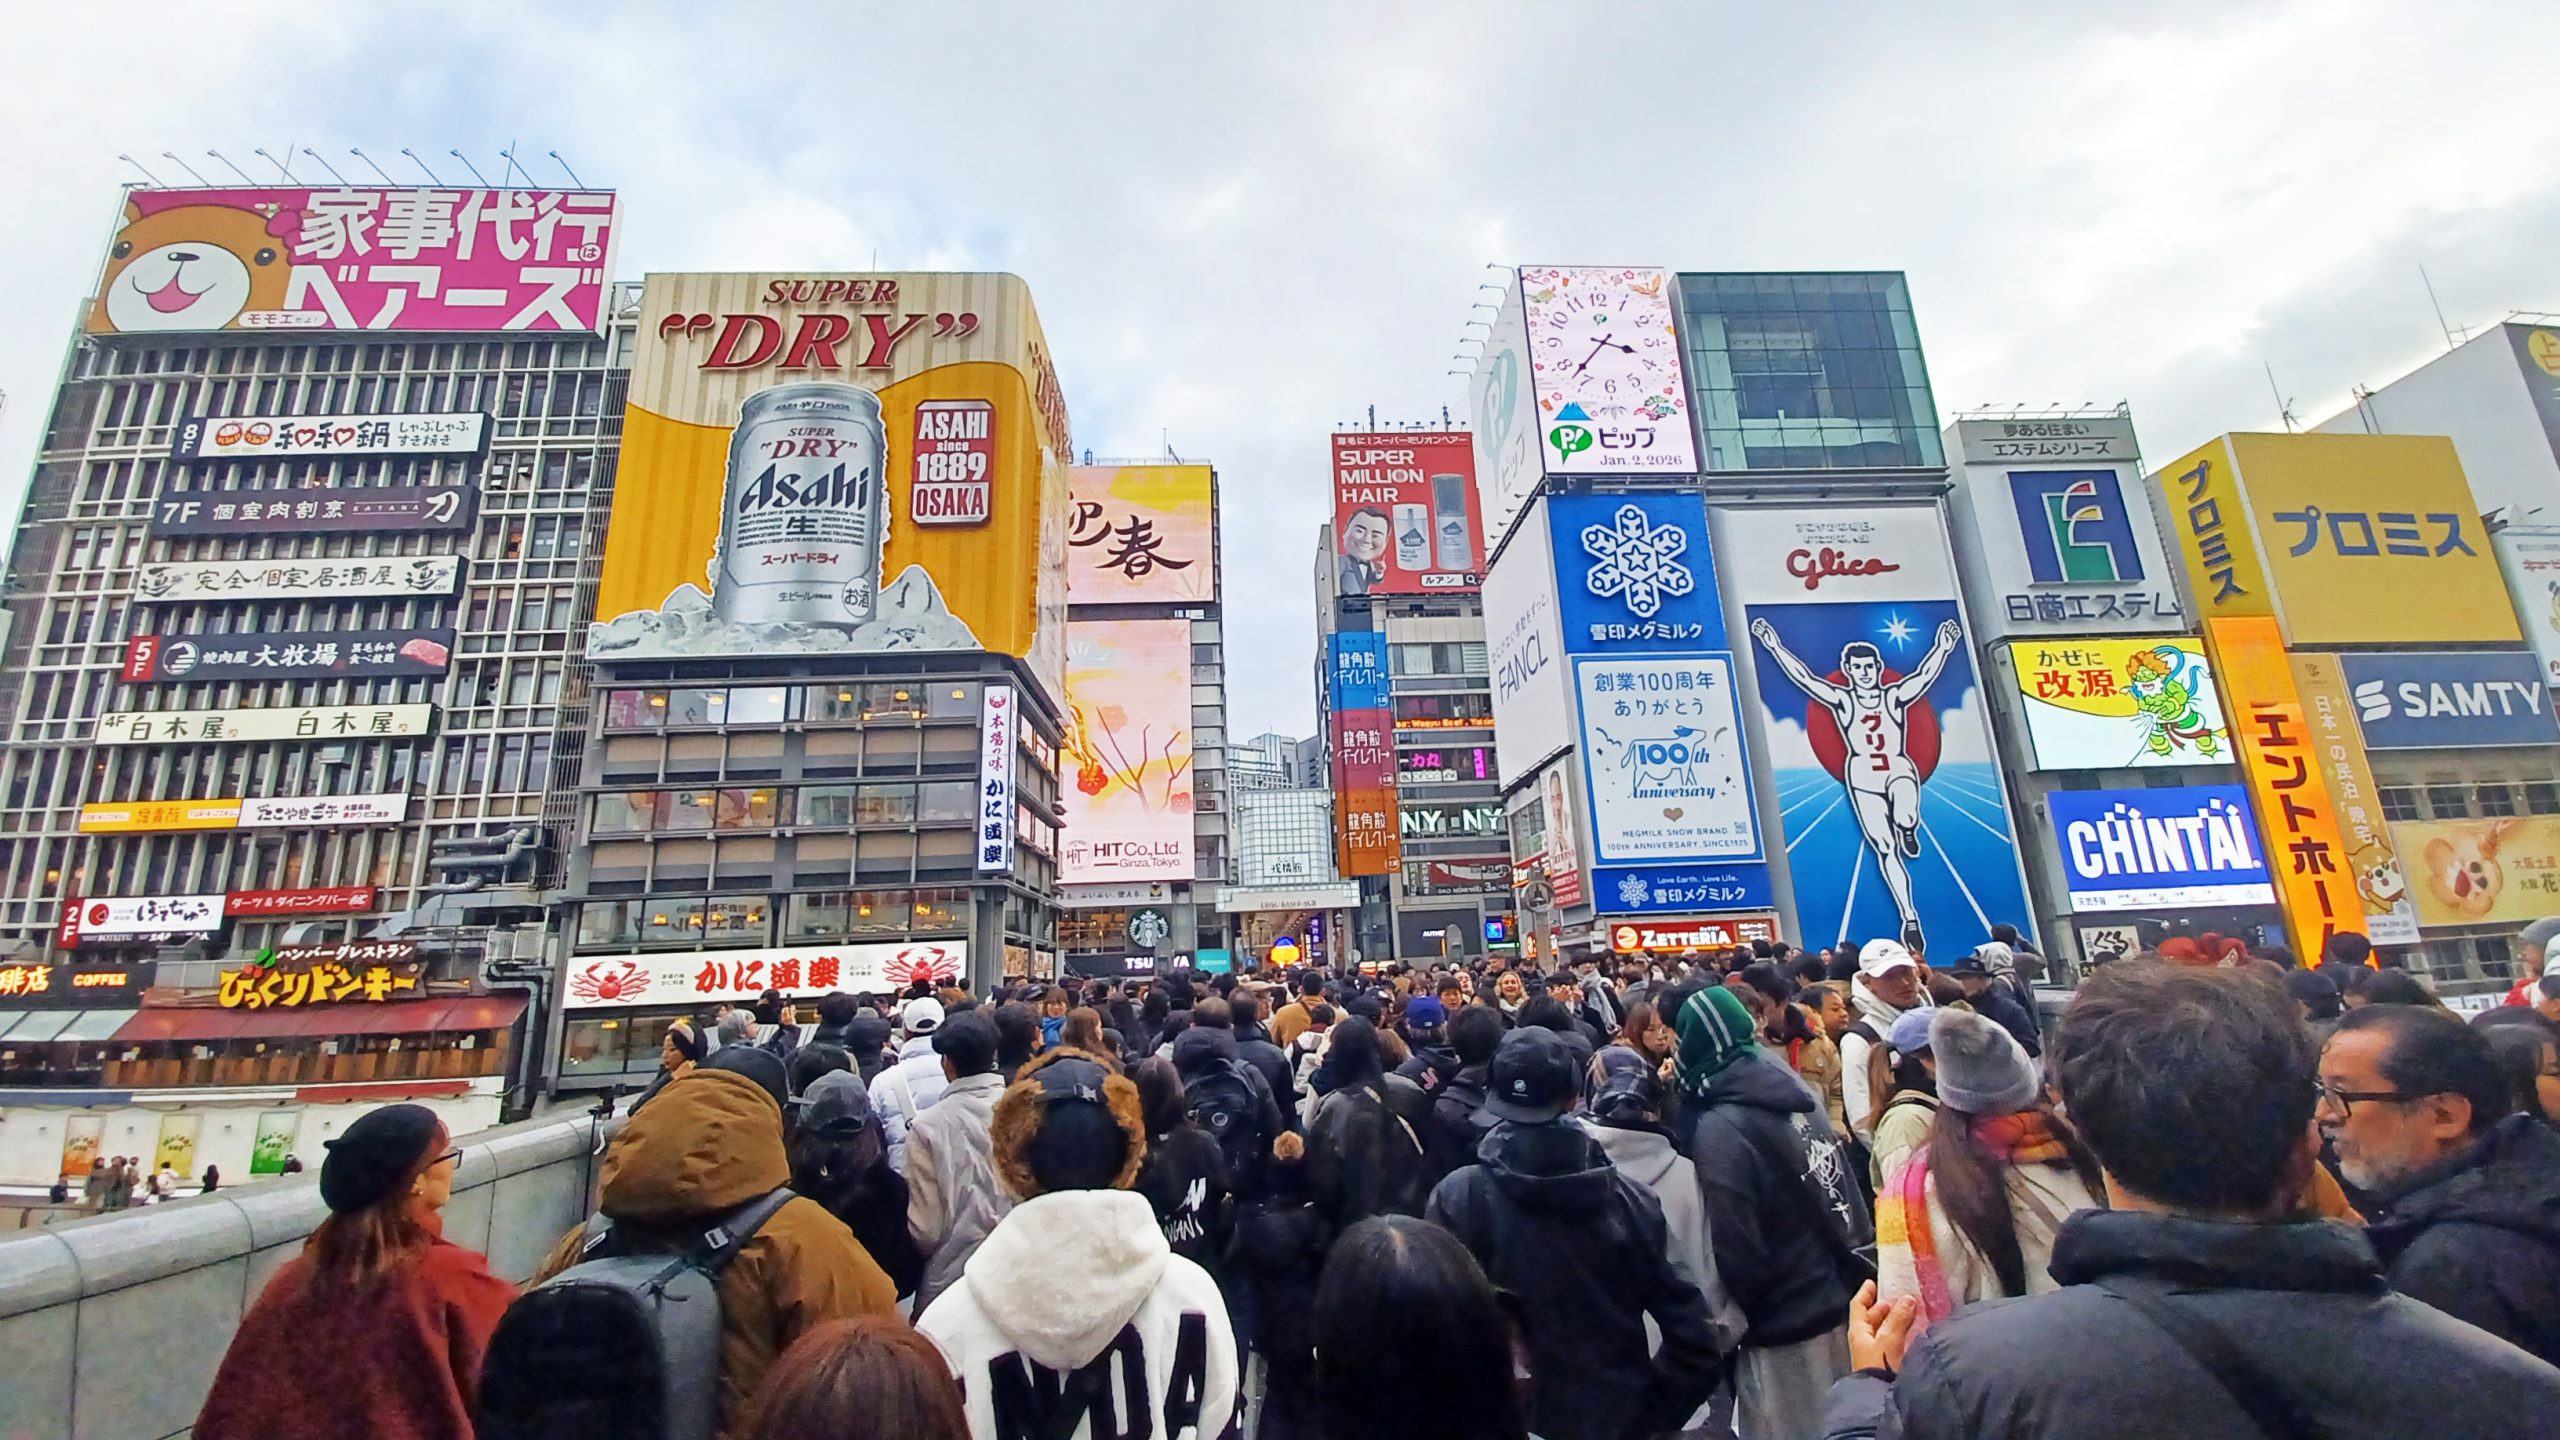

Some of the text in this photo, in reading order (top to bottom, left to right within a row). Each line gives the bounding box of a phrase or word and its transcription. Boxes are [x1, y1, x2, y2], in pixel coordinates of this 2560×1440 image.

[295, 188, 611, 261] 家事代行
[284, 265, 602, 329] ベアーズ
[763, 279, 900, 303] SUPER
[1567, 296, 1584, 313] 11
[1588, 293, 1607, 307] 12
[1619, 299, 1627, 312] 1
[248, 313, 293, 324] モモエ
[1549, 311, 1568, 330] 10
[1634, 315, 1650, 328] 2
[1547, 337, 1563, 348] 9
[1643, 337, 1661, 348] 3
[1556, 358, 1573, 371] 8
[1642, 358, 1657, 371] 4
[1580, 374, 1594, 386] 7
[1604, 379, 1617, 393] 6
[1627, 373, 1641, 388] 5
[399, 420, 471, 433] しゃぶしゃぶ
[788, 427, 835, 437] SUPER
[918, 411, 988, 441] ASAHI
[2003, 424, 2089, 437] 夢ある住まい
[936, 441, 970, 452] since
[1598, 427, 1656, 449] ピップ
[1994, 441, 2111, 456] エステムシリーズ
[1340, 450, 1414, 465] SUPER
[1600, 455, 1632, 467] Jan.
[1648, 454, 1683, 466] 2026
[916, 453, 986, 482] 1889
[1341, 468, 1424, 484] MILLION
[738, 462, 870, 514] Asahi
[1342, 487, 1398, 503] HAIR
[422, 491, 460, 523] 刀
[915, 488, 985, 517] OSAKA
[162, 502, 201, 524] 7F
[786, 515, 818, 536] 生
[2179, 459, 2248, 605] プロミス
[2272, 505, 2478, 558] プロミス
[761, 553, 839, 566] スーパードライ
[1786, 547, 1900, 590] Glico
[195, 568, 396, 591] 完全個室居酒屋
[1425, 576, 1455, 584] ルアン
[2005, 593, 2182, 622] 日商エステム
[1591, 624, 1703, 641] 雪印メグミルク
[132, 641, 152, 677] 5F
[249, 642, 339, 668] 大牧場
[1338, 652, 1375, 667] 龍角散
[2036, 649, 2103, 667] かぜに
[1498, 629, 1549, 706] FANCL
[1595, 671, 1716, 692] 創業100周年
[2033, 669, 2118, 699] 改源
[1614, 698, 1705, 717] ありがとう
[2398, 681, 2541, 717] SAMTY
[104, 715, 127, 728] 4F
[130, 716, 225, 741] 白木屋
[296, 711, 394, 736] 白木屋
[989, 713, 1005, 772] 本場の味
[1343, 730, 1381, 747] 龍角散
[1859, 712, 1890, 772] グリコ
[1348, 812, 1386, 829] 龍角散
[1401, 810, 1441, 833] NY
[1462, 808, 1502, 830] NY
[1622, 830, 1663, 838] MEGMILK
[1697, 827, 1728, 835] BRAND
[1094, 843, 1123, 857] HIT
[1634, 841, 1698, 850] ANNIVERSARY
[1676, 875, 1700, 883] Earth.
[1721, 874, 1739, 882] Life.
[231, 897, 263, 909] ダーツ
[1653, 885, 1746, 904] 雪印メグミルク
[61, 906, 78, 941] 2F
[1641, 930, 1732, 948] ZETTERIA
[276, 944, 413, 960] ハンバーグレストラン
[72, 973, 128, 987] COFFEE
[218, 963, 418, 1009] びっくりドンキー
